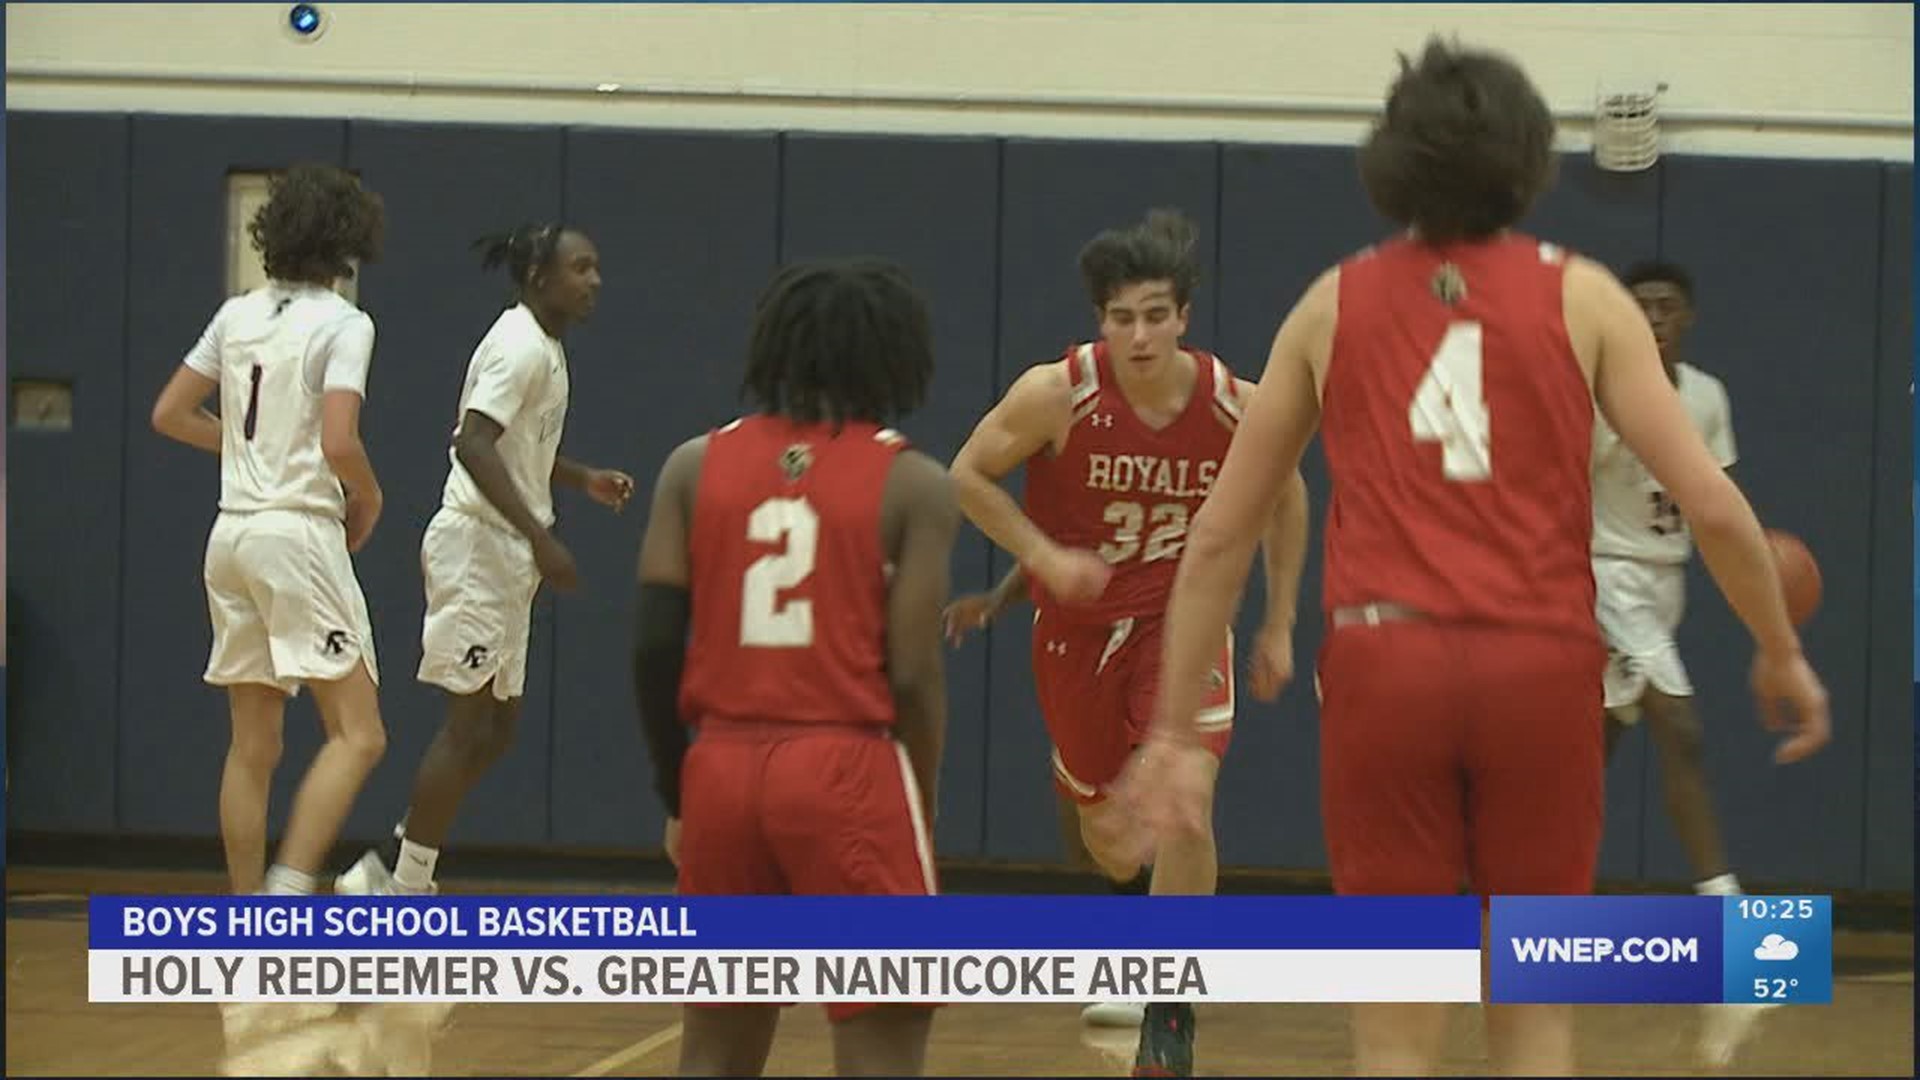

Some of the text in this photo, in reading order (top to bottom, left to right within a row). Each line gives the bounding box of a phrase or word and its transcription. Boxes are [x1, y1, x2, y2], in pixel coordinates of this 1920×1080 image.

[244, 363, 264, 441] 1
[1408, 319, 1493, 481] 4
[1086, 453, 1218, 498] ROYALS
[740, 495, 819, 647] 2
[1100, 500, 1191, 565] 32
